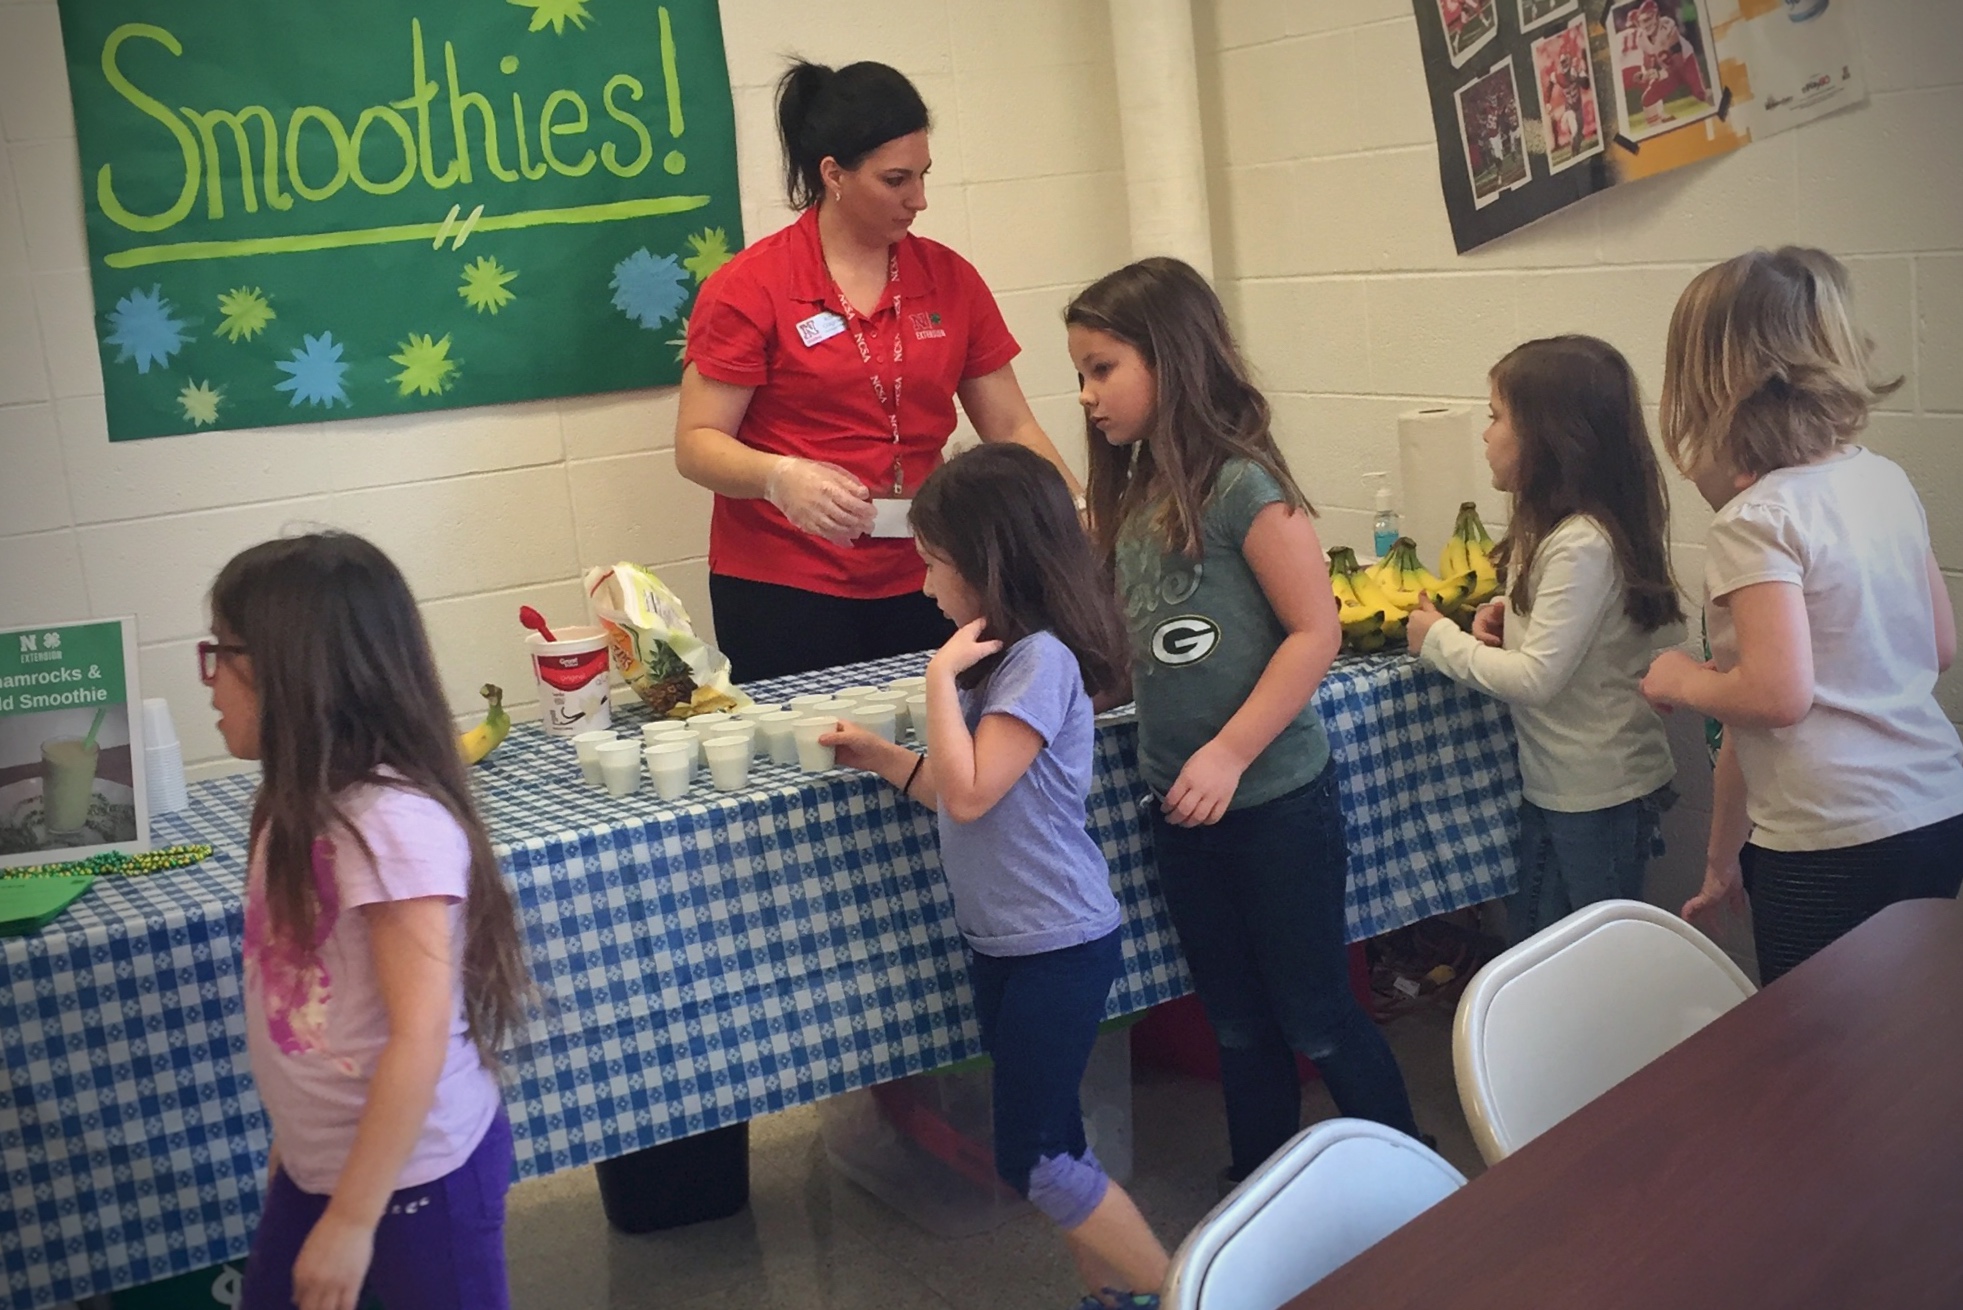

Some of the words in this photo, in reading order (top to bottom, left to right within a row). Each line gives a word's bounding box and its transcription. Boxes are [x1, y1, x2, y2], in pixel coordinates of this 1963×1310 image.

[97, 6, 686, 232] Smoothies!
[838, 294, 856, 320] NCSA
[854, 332, 871, 363] NCSA
[870, 375, 887, 404] NCSA
[20, 634, 37, 652] N
[1152, 618, 1215, 664] G
[21, 650, 63, 664] EXTENSION
[0, 667, 82, 689] amrocks
[88, 664, 102, 679] &
[20, 686, 107, 709] Smoothie
